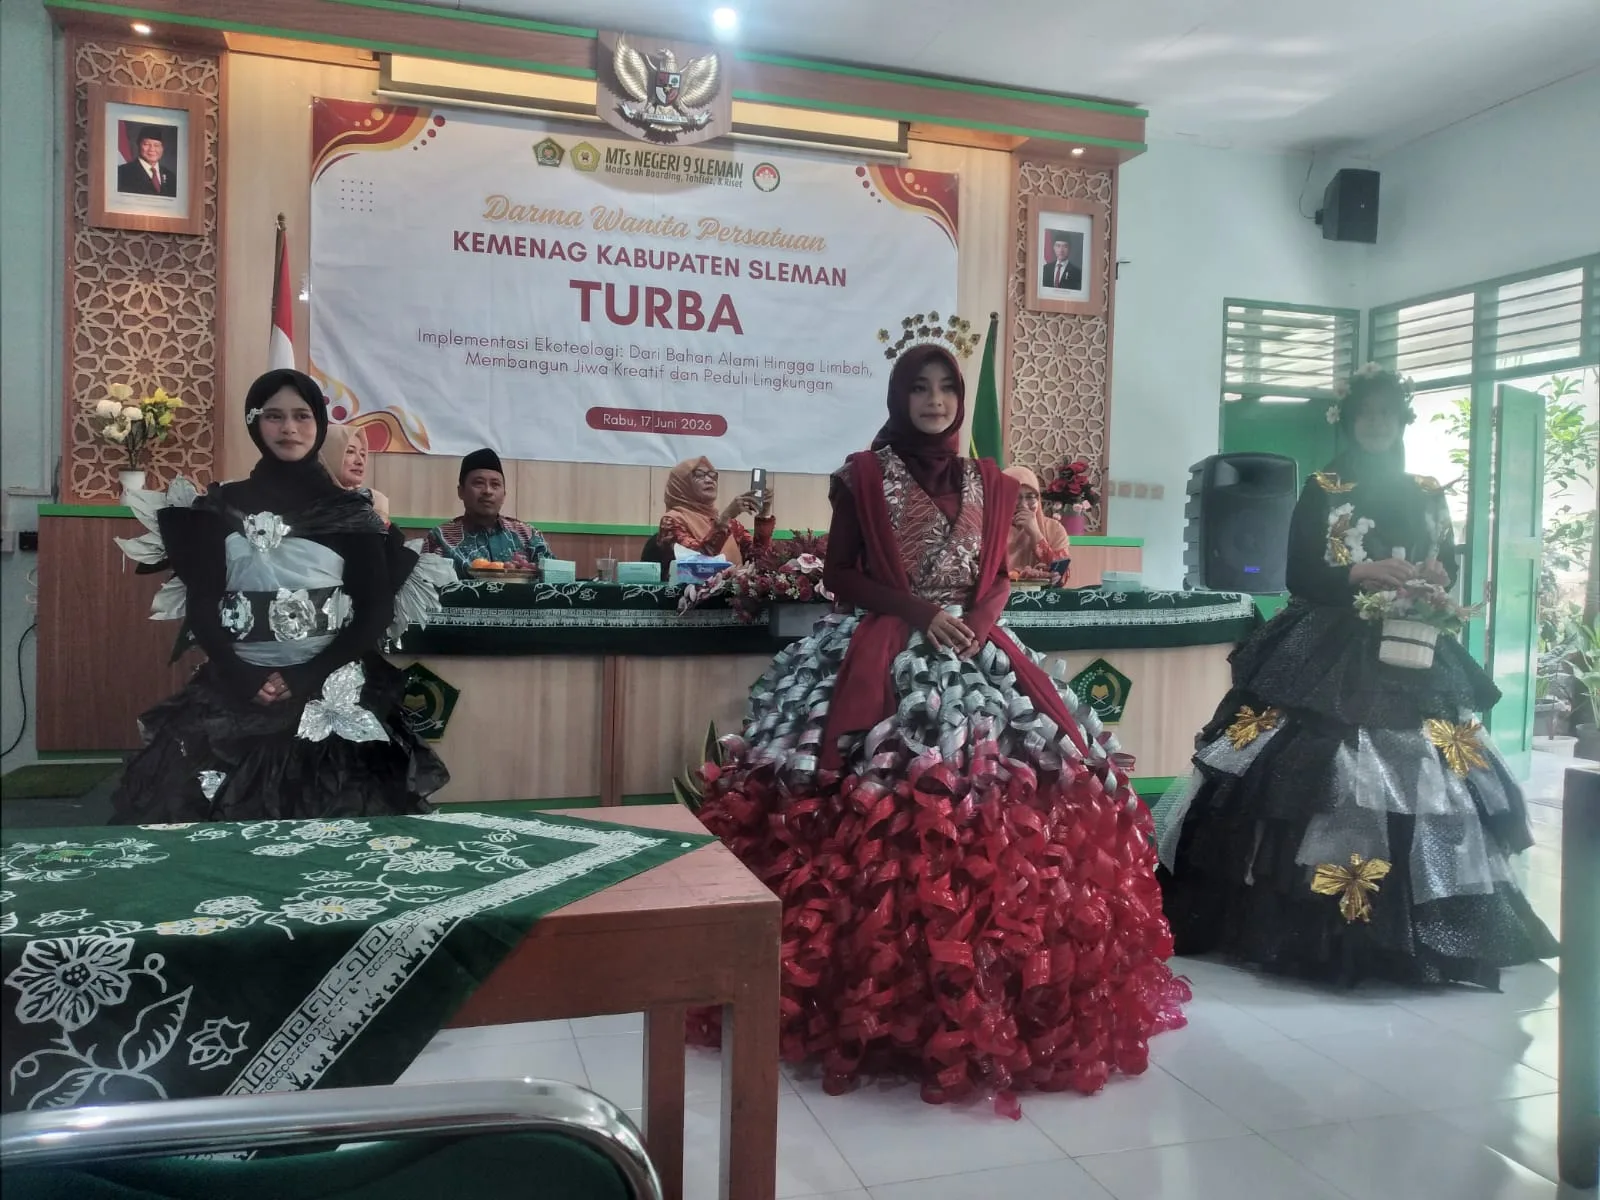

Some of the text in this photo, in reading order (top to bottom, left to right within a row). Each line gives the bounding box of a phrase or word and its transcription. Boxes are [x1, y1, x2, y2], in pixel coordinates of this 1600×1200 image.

[605, 147, 744, 179] MTs NEGERI 9 SLEMAN
[605, 164, 644, 177] Madrasah
[482, 194, 826, 251] Darma Wanita Persatuan
[453, 230, 847, 287] KEMENAG KABUPATEN SLEMAN
[569, 279, 744, 335] TURBA
[418, 328, 873, 378] Implementasi Ekoteologi: Dari Bahan Alami Hingga Limbah,
[465, 352, 833, 393] Membangun Jiwa Kreatif dan Peduli Lingkungan
[603, 413, 712, 431] Rabu, 17 Juni 2026
